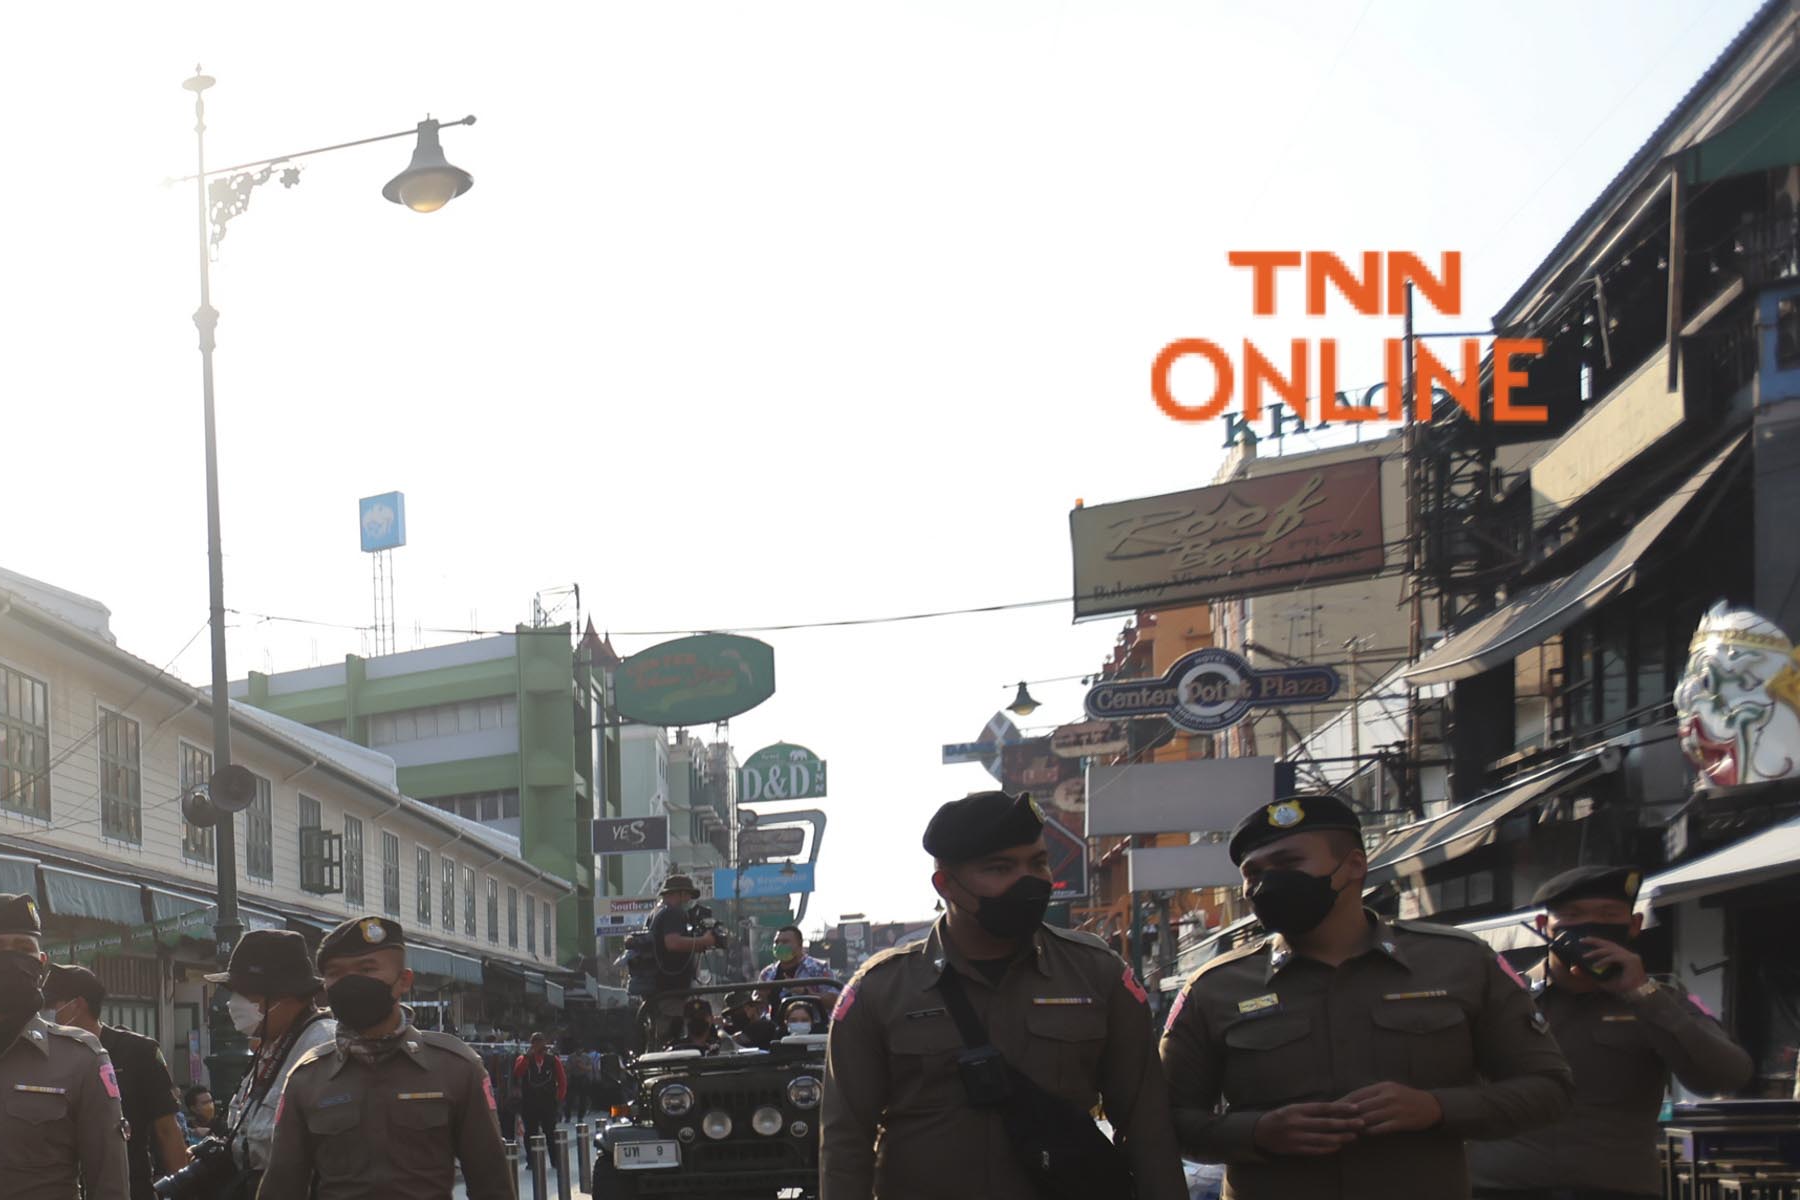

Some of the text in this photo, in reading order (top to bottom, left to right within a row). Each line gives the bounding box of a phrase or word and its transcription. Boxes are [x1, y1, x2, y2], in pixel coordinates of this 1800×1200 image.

[1096, 675, 1329, 711] Center Point Plaza
[742, 763, 810, 802] D&D
[612, 820, 646, 845] YES
